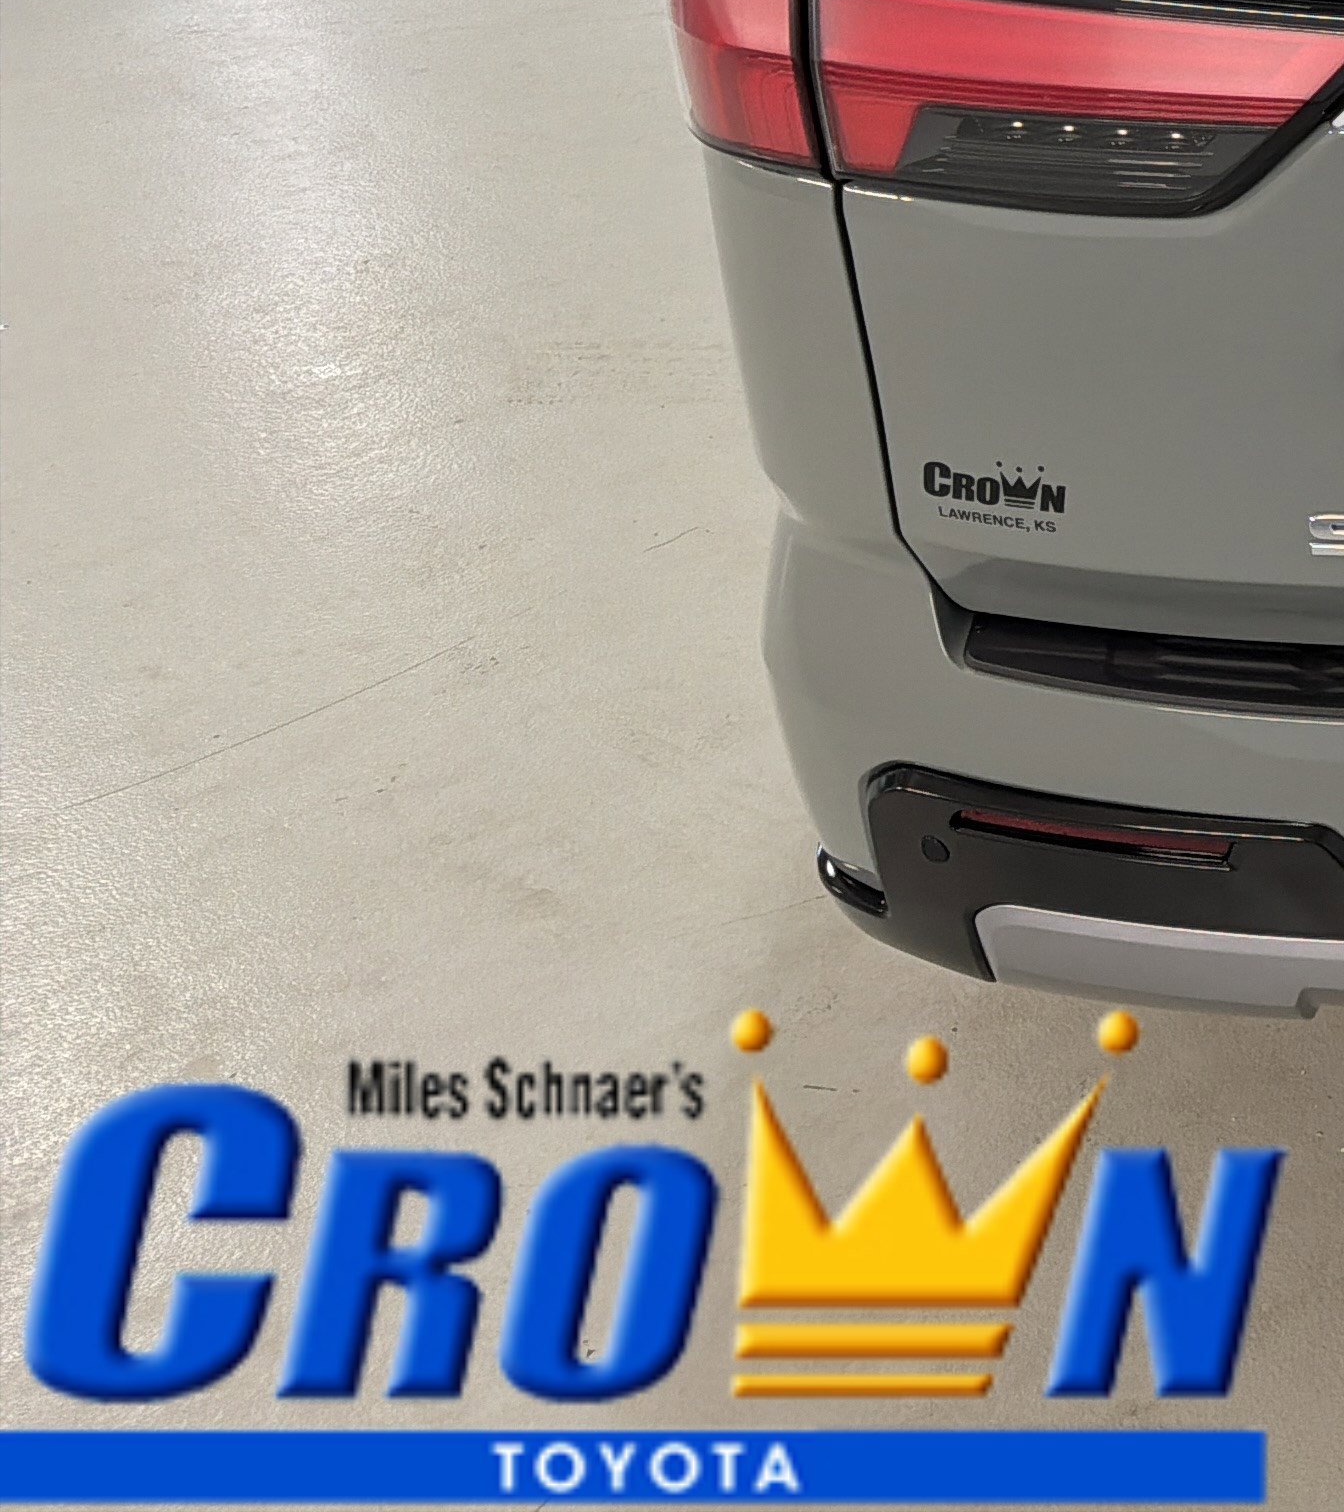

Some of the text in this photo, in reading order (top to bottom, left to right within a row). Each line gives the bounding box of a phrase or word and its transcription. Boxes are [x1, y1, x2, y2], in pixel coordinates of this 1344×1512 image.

[923, 460, 1067, 514] CROWN
[938, 505, 1058, 534] LAWRENCE, KS
